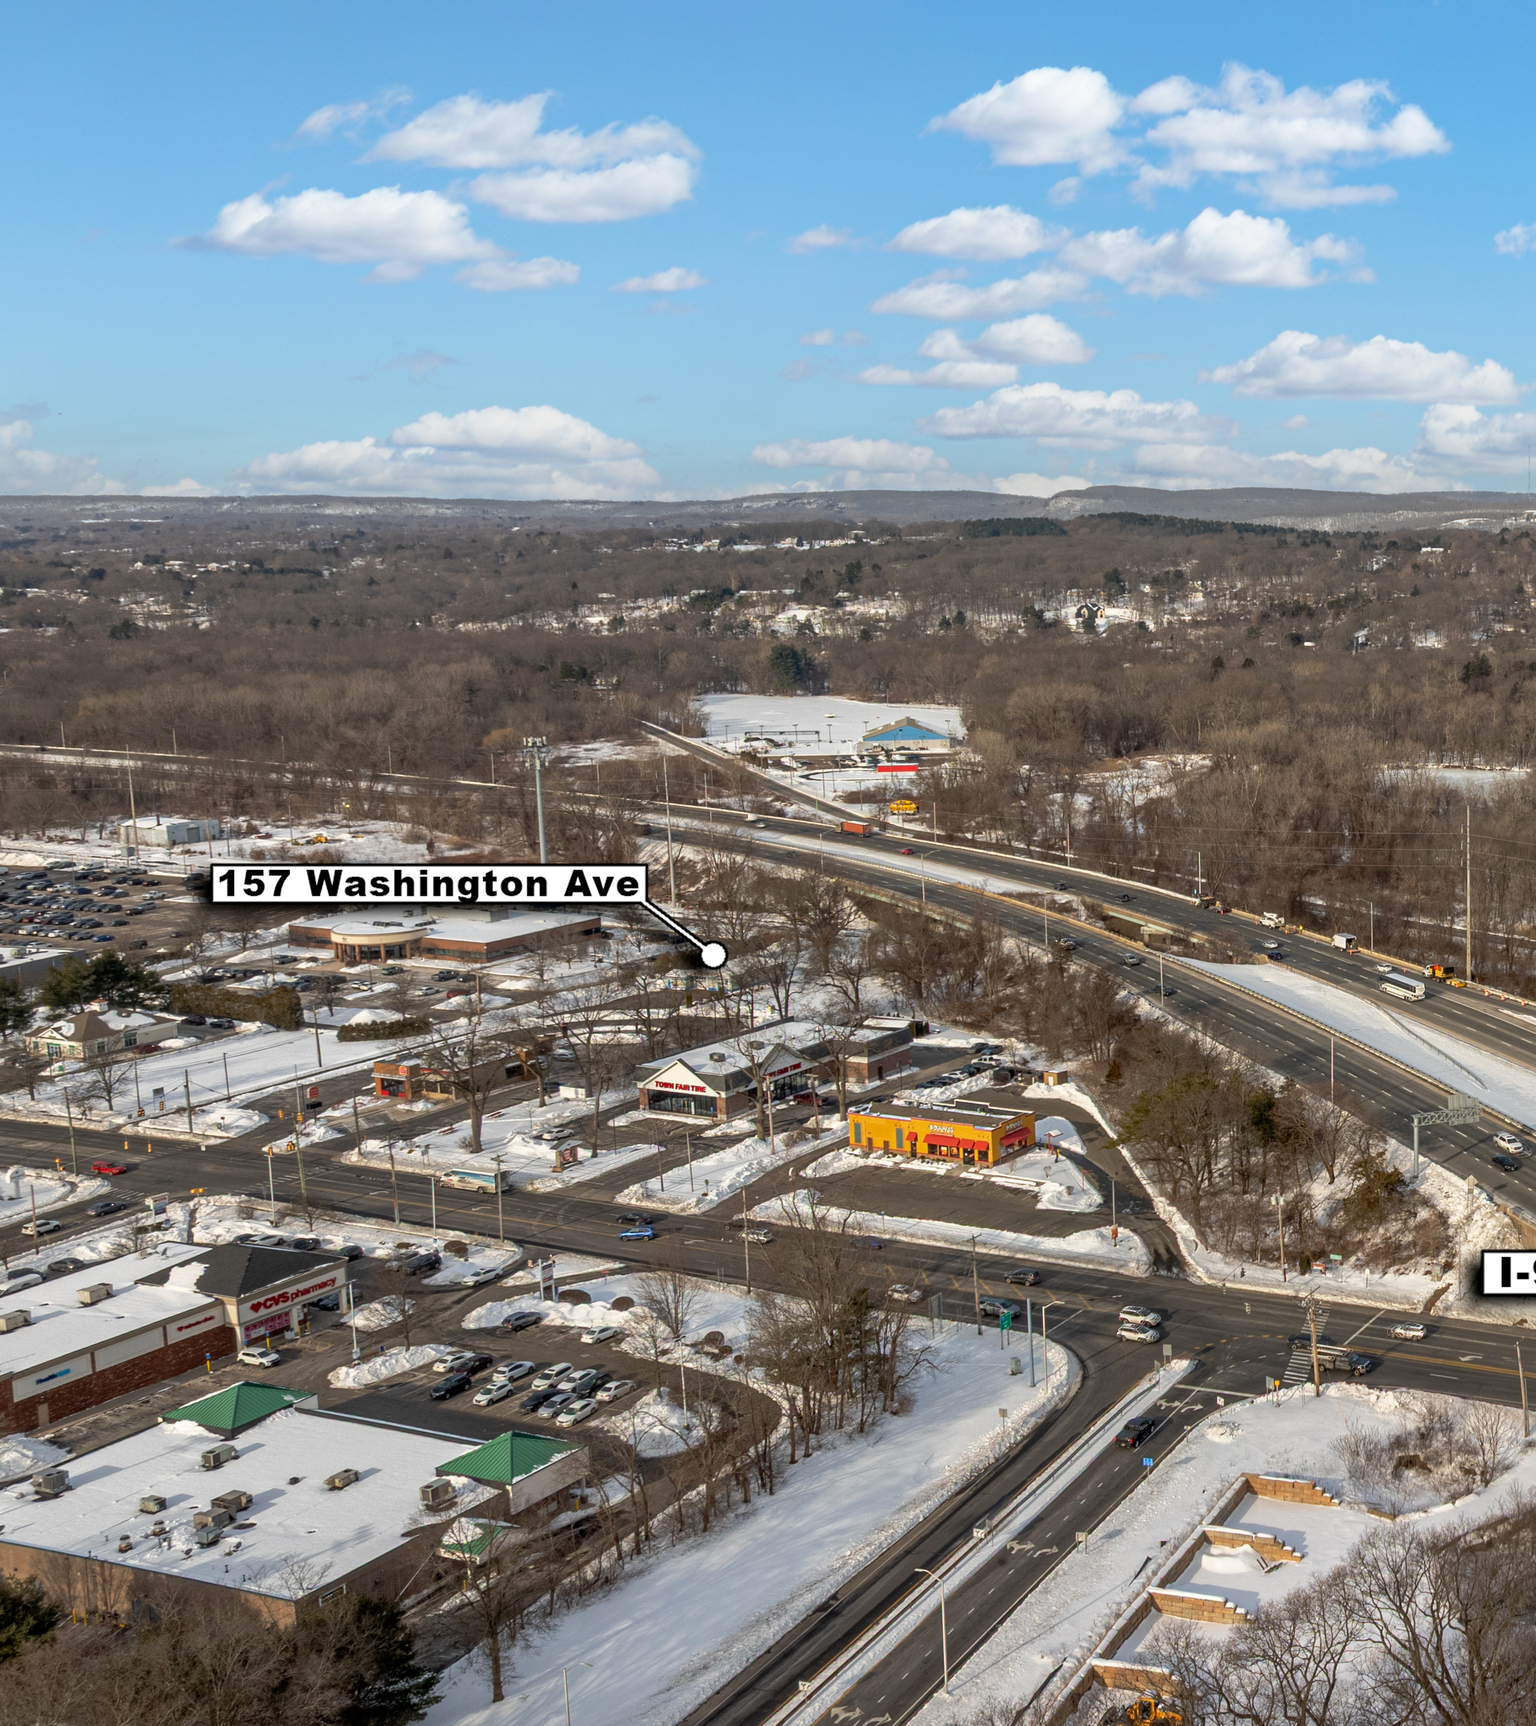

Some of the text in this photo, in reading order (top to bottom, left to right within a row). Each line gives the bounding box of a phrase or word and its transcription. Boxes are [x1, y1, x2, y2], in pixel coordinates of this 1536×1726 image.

[655, 1080, 707, 1093] TOWN FAIR TIRE
[263, 1277, 337, 1309] CVS pharmacy
